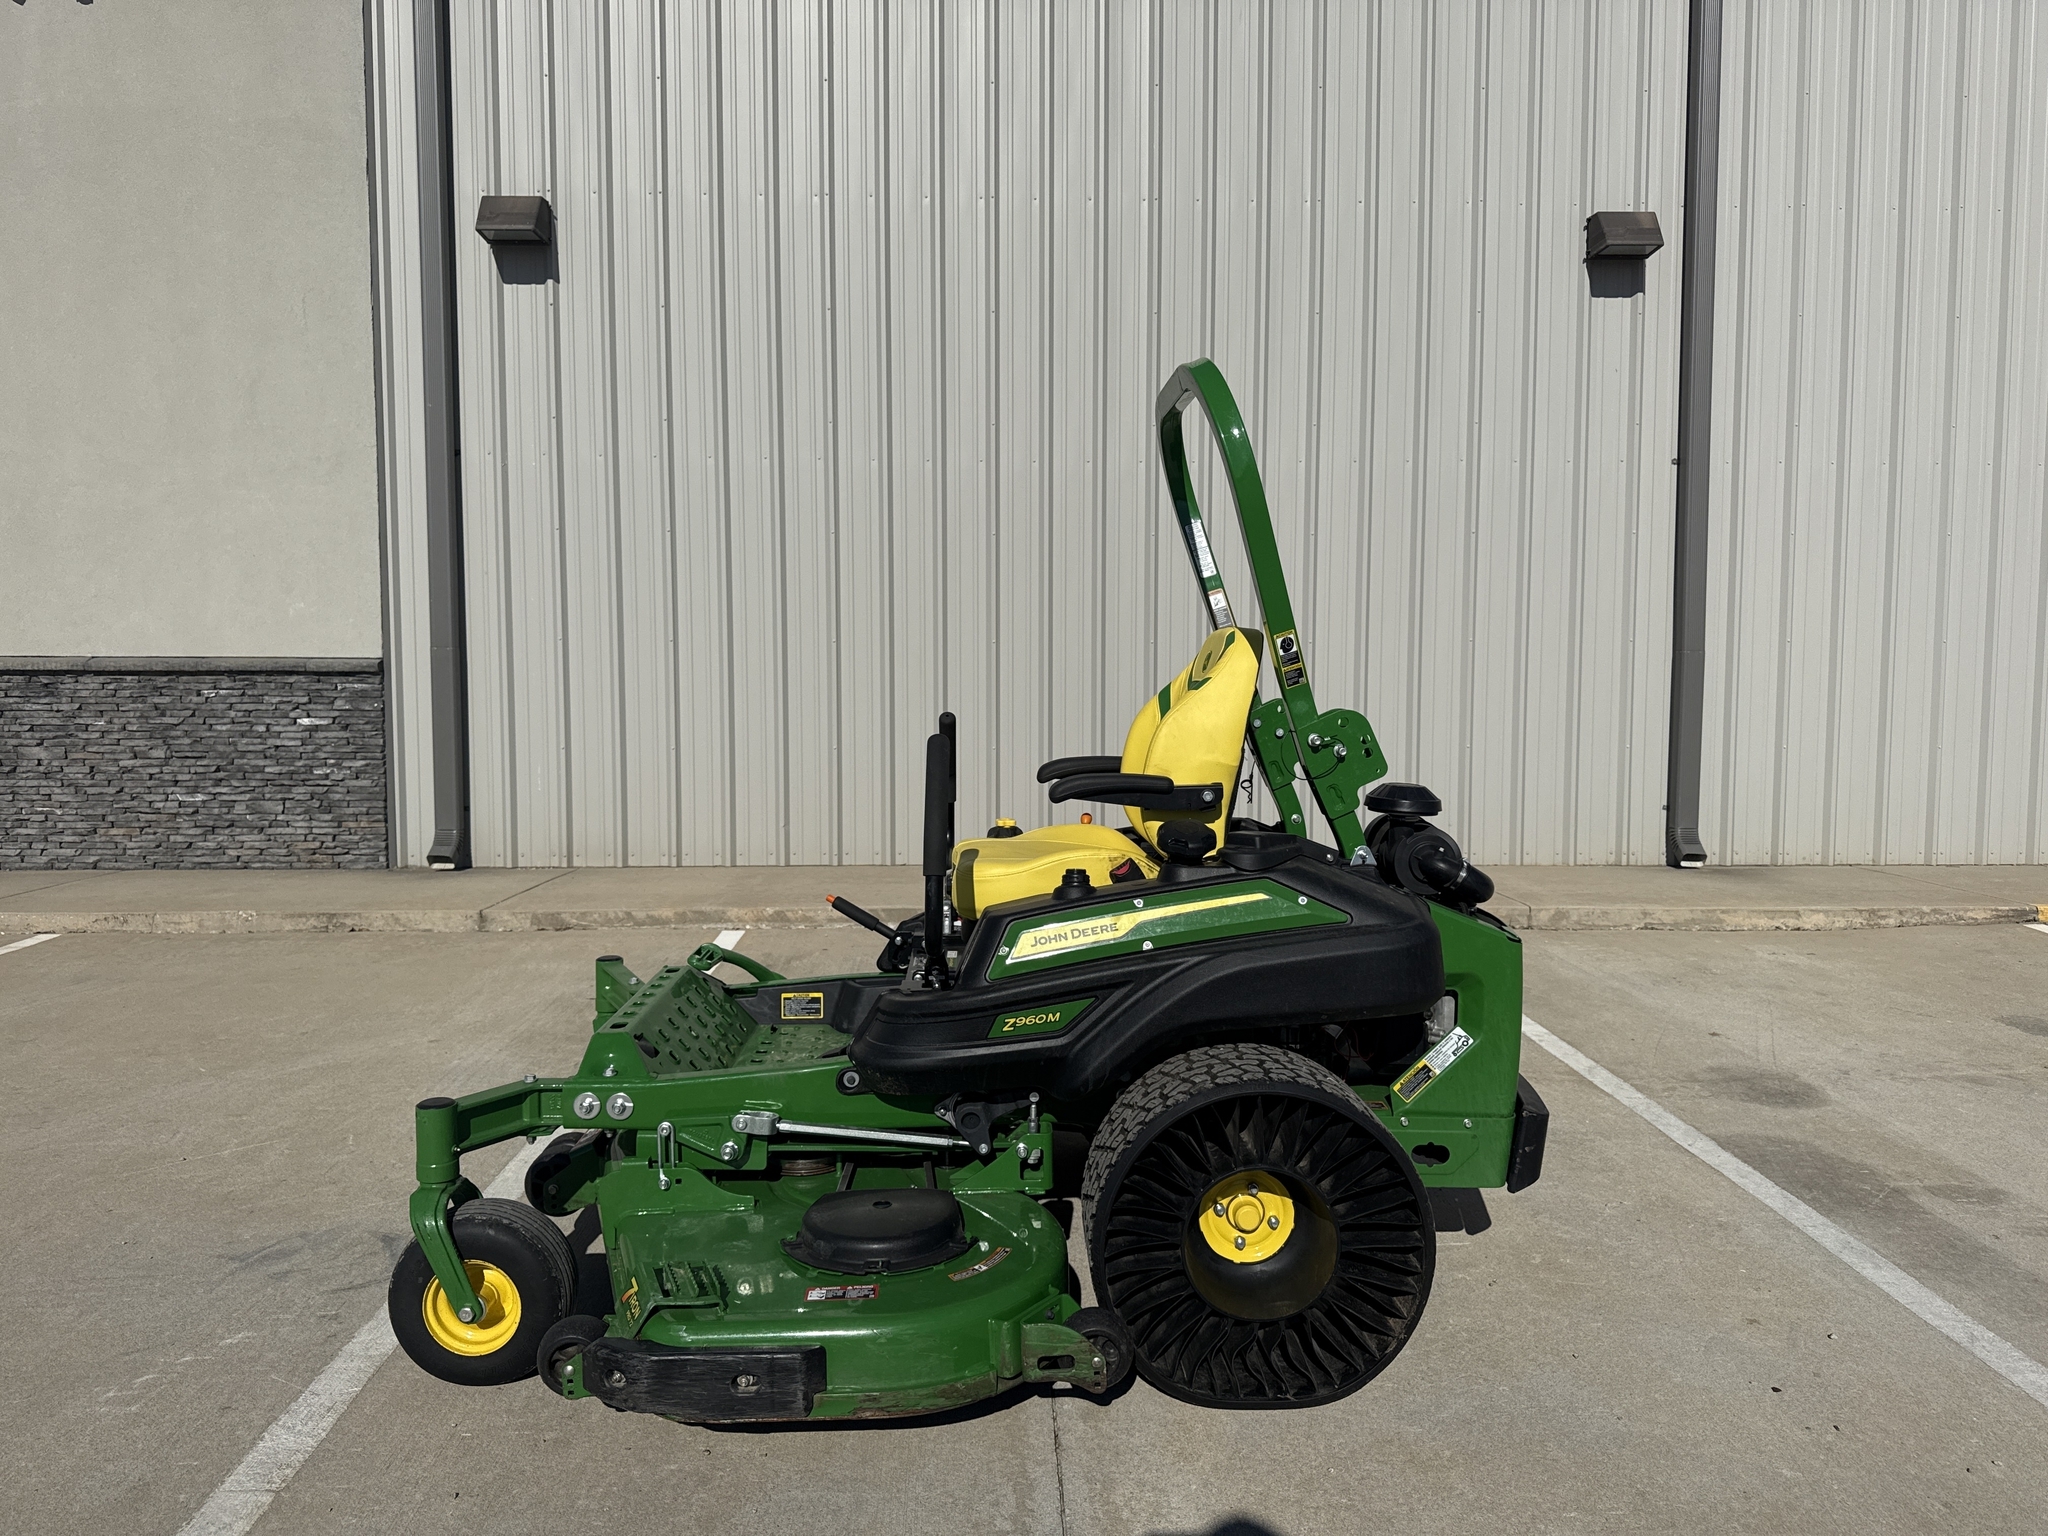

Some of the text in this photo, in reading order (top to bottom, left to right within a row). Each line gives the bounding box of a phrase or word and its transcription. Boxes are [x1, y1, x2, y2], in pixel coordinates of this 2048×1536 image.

[1030, 922, 1119, 948] JOHN DEERE
[1002, 1011, 1061, 1032] Z960M
